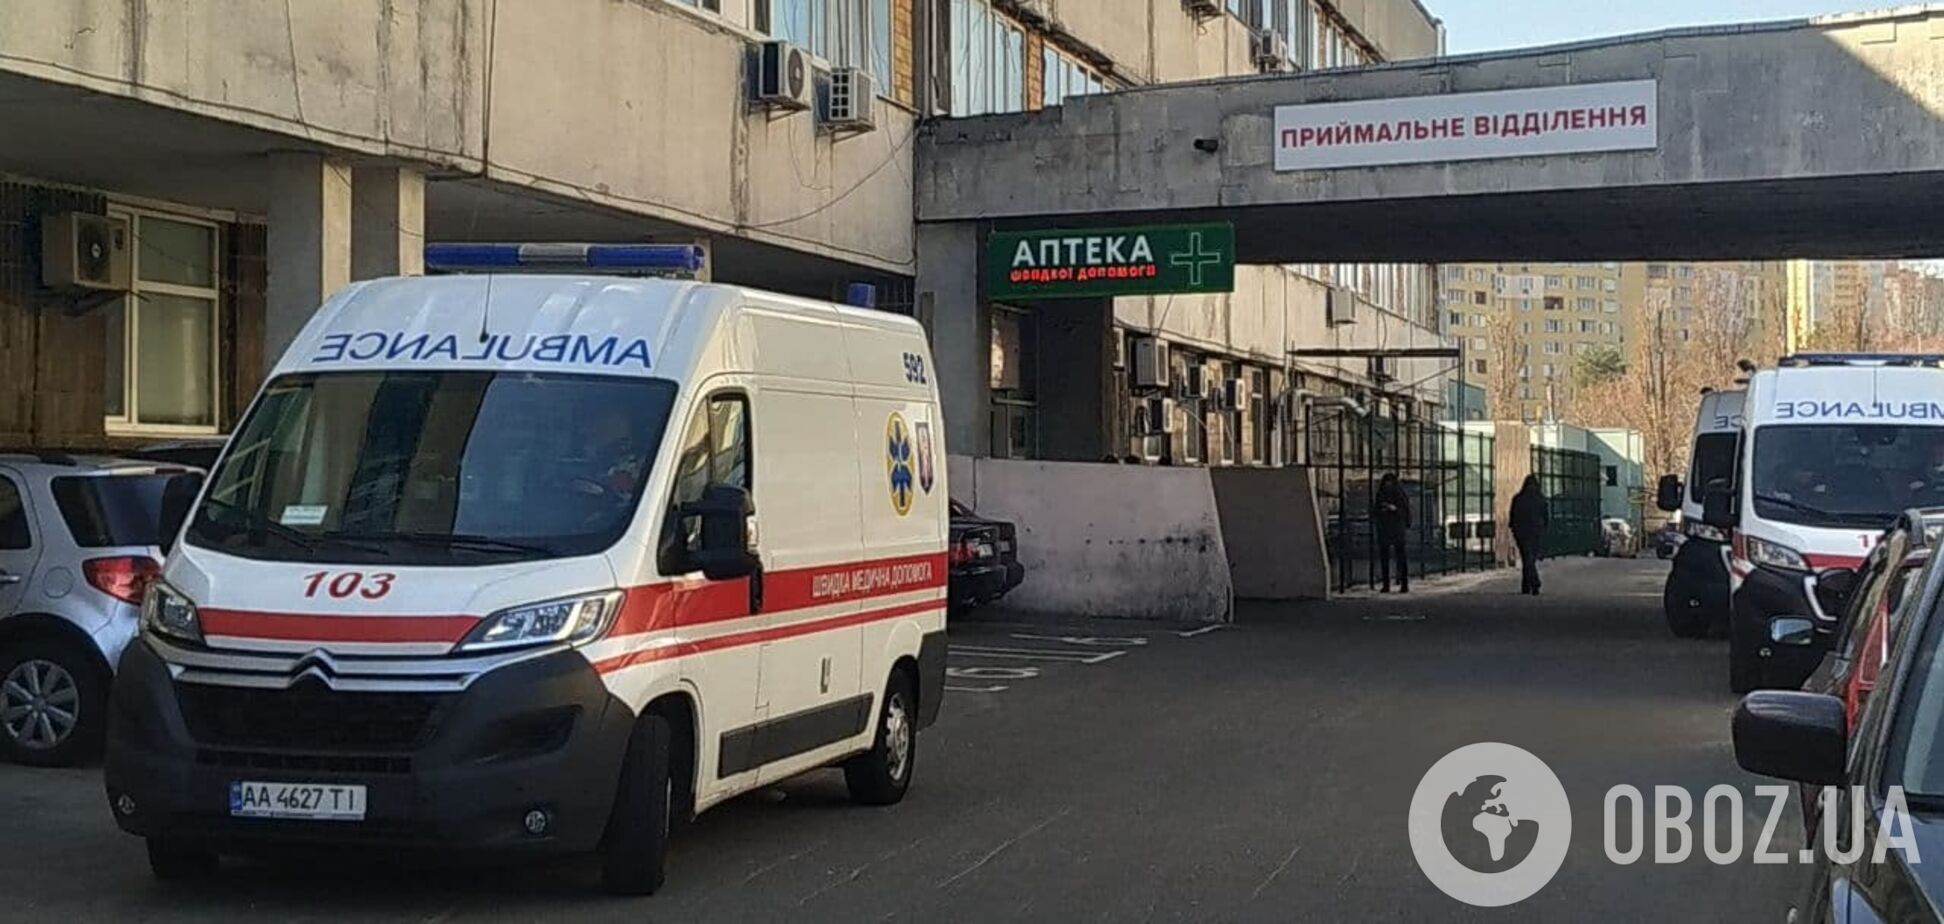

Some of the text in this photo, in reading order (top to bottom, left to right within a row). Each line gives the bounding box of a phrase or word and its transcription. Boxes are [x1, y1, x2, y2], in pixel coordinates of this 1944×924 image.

[1281, 105, 1647, 148] ПРИЙМАЛЬНЕ ВІДДІЛЕННЯ
[1012, 235, 1154, 267] АПТЕКА
[903, 352, 927, 385] 592
[304, 571, 396, 600] 103
[812, 561, 932, 598] ШВИДКА МЕДИЧНА ДОПОМОГА
[243, 785, 271, 807] AA
[277, 787, 323, 810] 4627
[328, 788, 354, 811] TI
